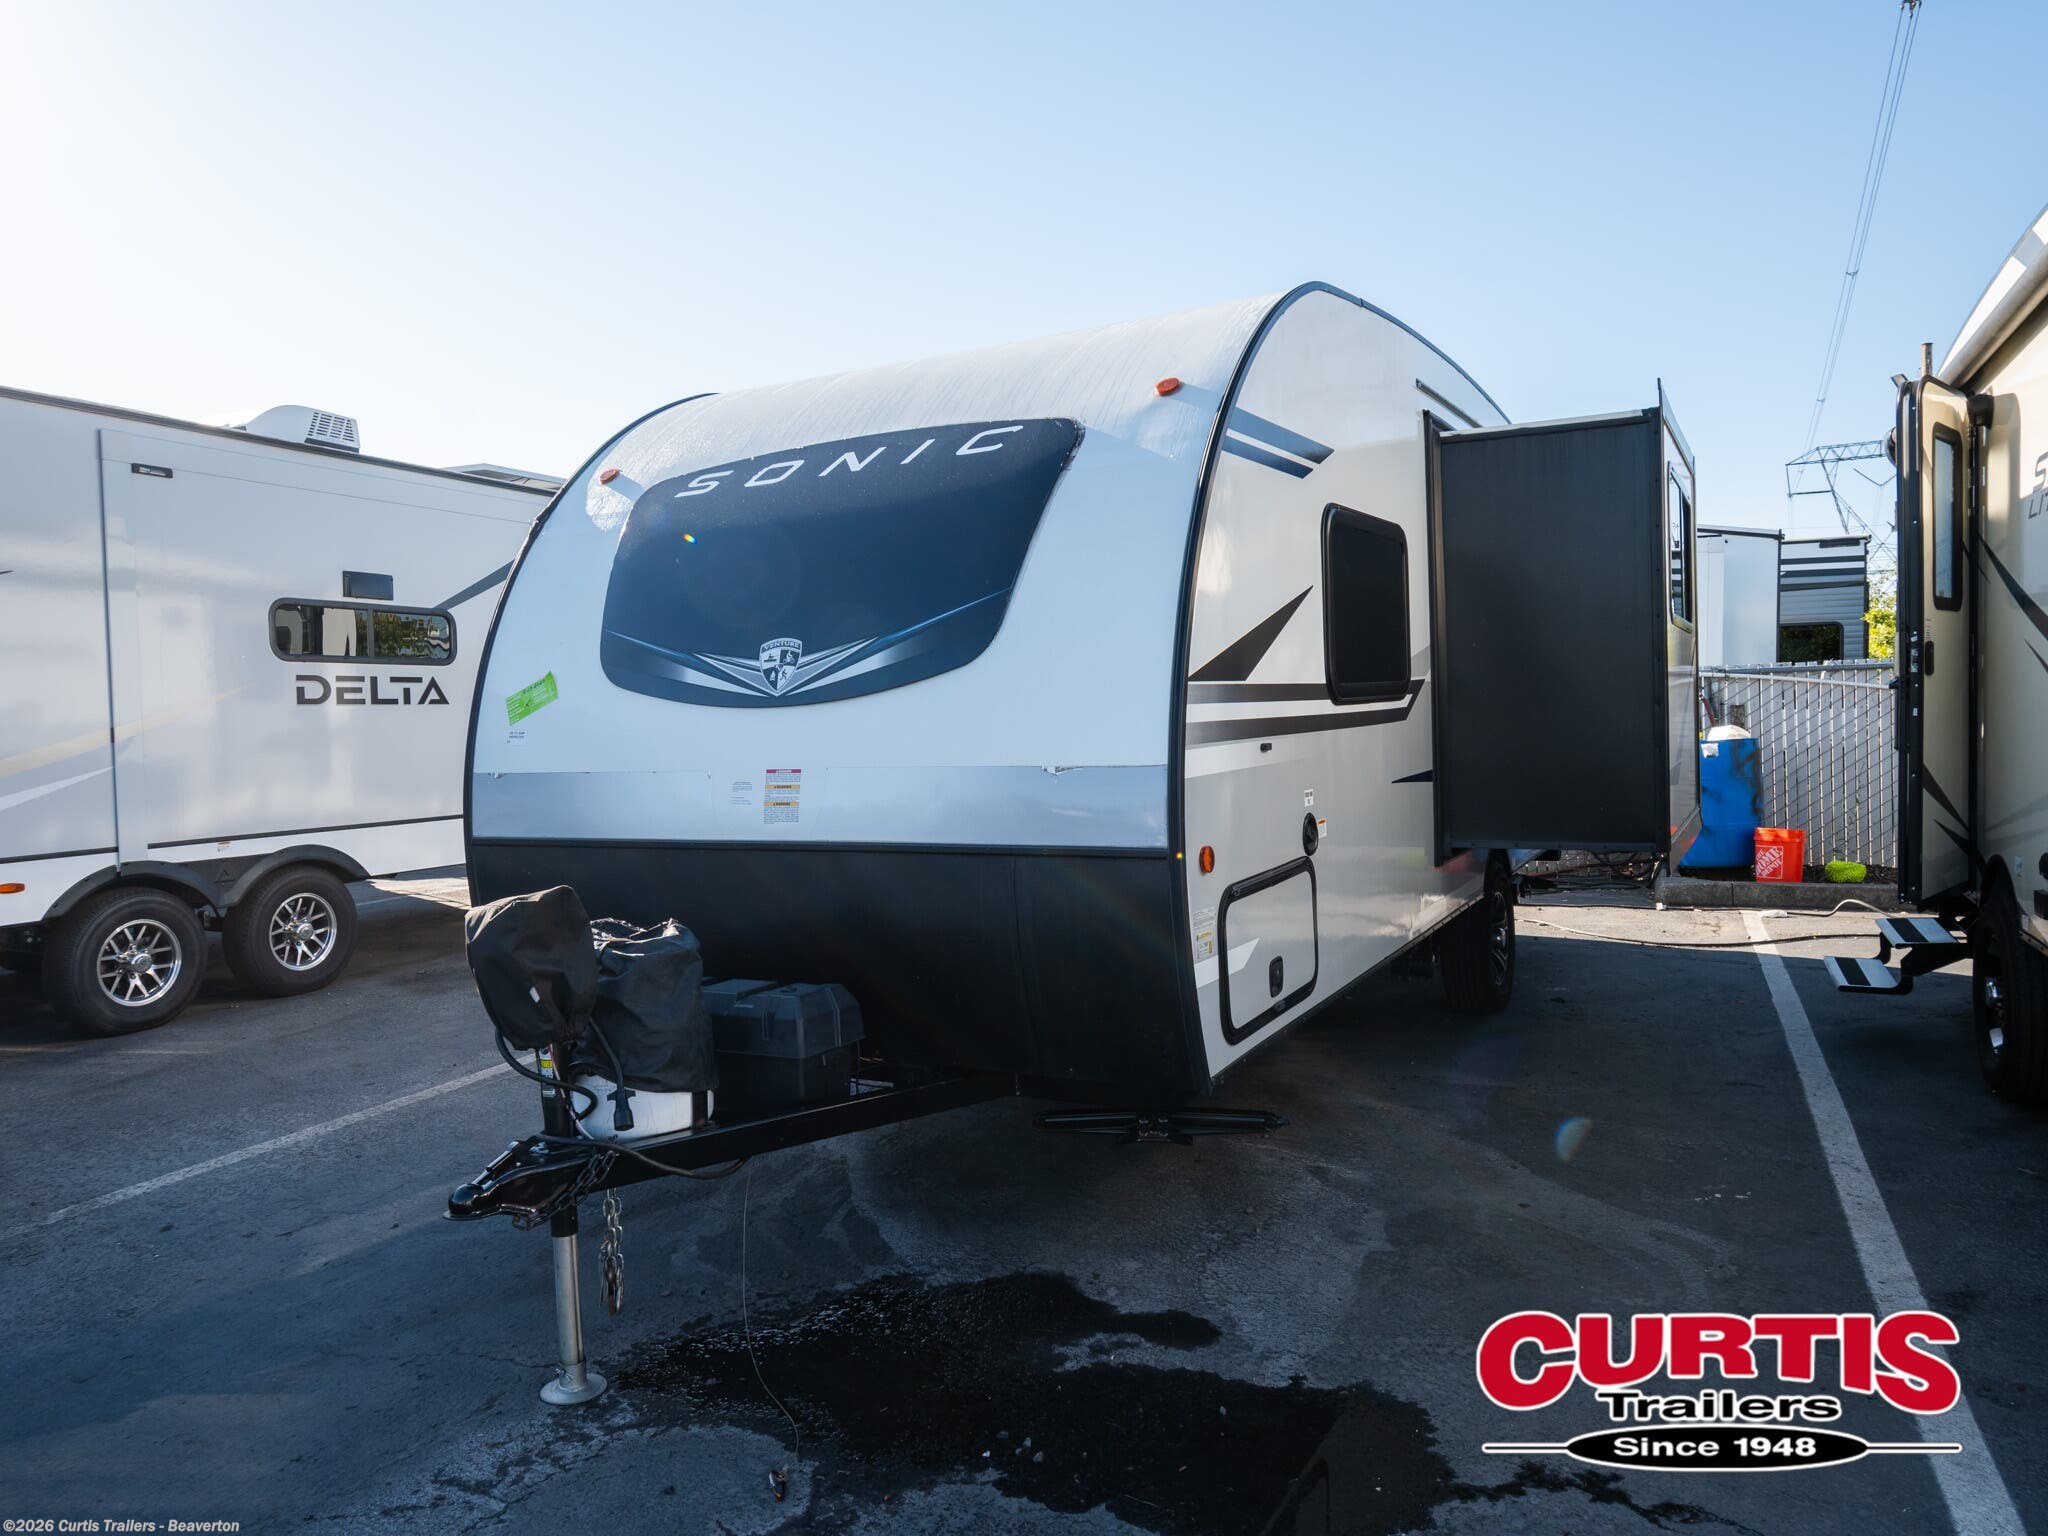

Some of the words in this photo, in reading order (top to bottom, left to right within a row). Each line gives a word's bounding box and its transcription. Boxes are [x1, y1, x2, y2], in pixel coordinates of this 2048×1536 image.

[674, 425, 1024, 498] SONIC
[763, 640, 800, 651] VENTURE
[295, 674, 450, 705] DELTA
